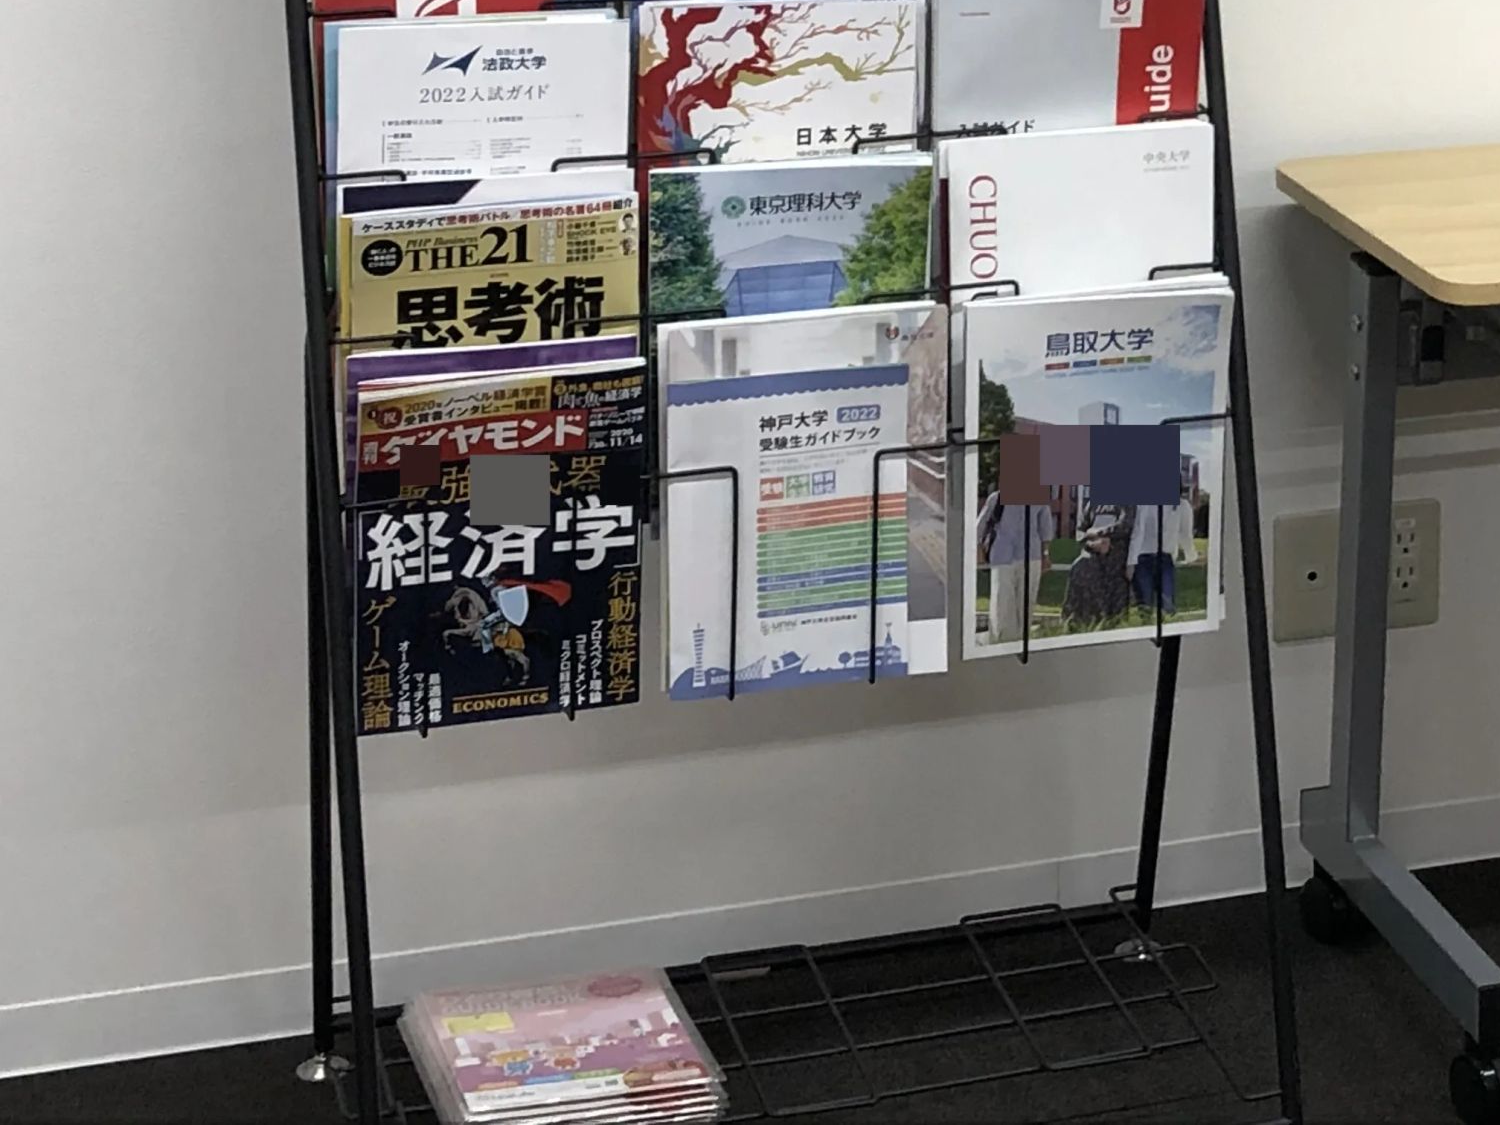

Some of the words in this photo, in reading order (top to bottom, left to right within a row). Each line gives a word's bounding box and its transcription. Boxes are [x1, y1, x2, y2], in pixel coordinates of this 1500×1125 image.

[482, 56, 547, 72] 法政大学
[419, 84, 551, 104] 2022入試ガイド
[796, 122, 887, 146] 日本大学
[749, 190, 862, 216] 東京理科大学
[966, 174, 999, 280] CHUO
[391, 275, 605, 350] 思考術
[1045, 327, 1155, 358] 鳥取大学
[759, 409, 829, 433] 神戸大学
[840, 406, 878, 422] 2022
[609, 433, 644, 447] 11/14
[759, 426, 881, 452] 受験生ガイドブック
[606, 571, 639, 702] 行動経済学
[361, 595, 398, 732] ゲーム理論
[451, 690, 549, 714] ECONOMICS
